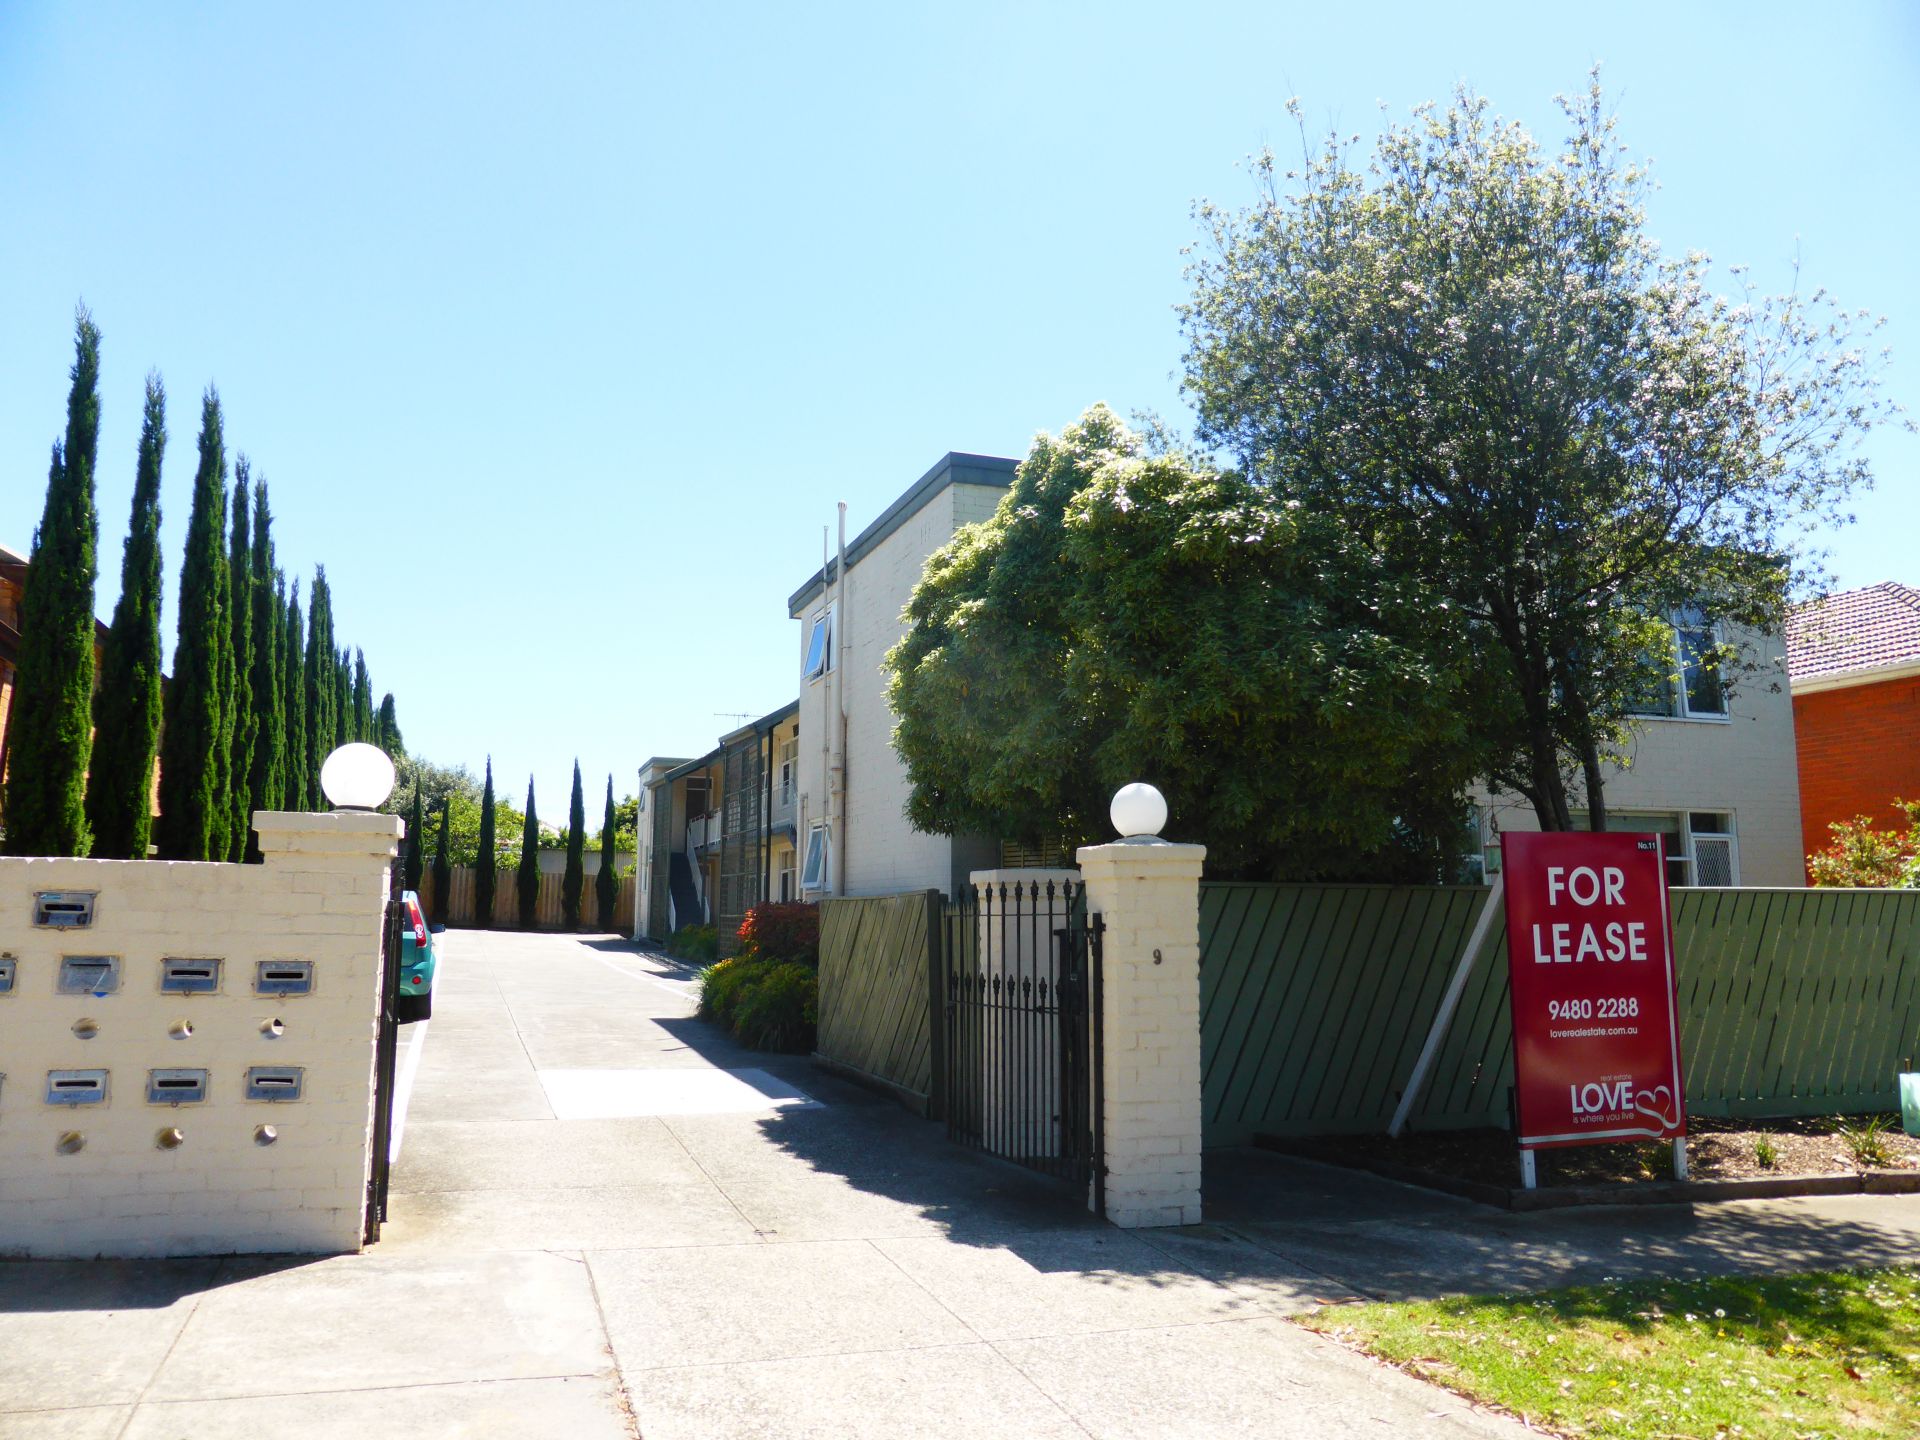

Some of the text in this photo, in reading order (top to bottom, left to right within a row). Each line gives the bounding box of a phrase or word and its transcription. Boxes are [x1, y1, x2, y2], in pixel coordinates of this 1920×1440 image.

[1637, 842, 1656, 850] No.11
[1547, 866, 1626, 906] FOR
[1532, 922, 1647, 964] LEASE
[1153, 949, 1162, 965] 9
[1548, 997, 1639, 1020] 9480 2288
[1549, 1027, 1638, 1039] loverealestate.com.au
[1571, 1081, 1634, 1113] LOVE
[1573, 1111, 1635, 1124] is where you live
